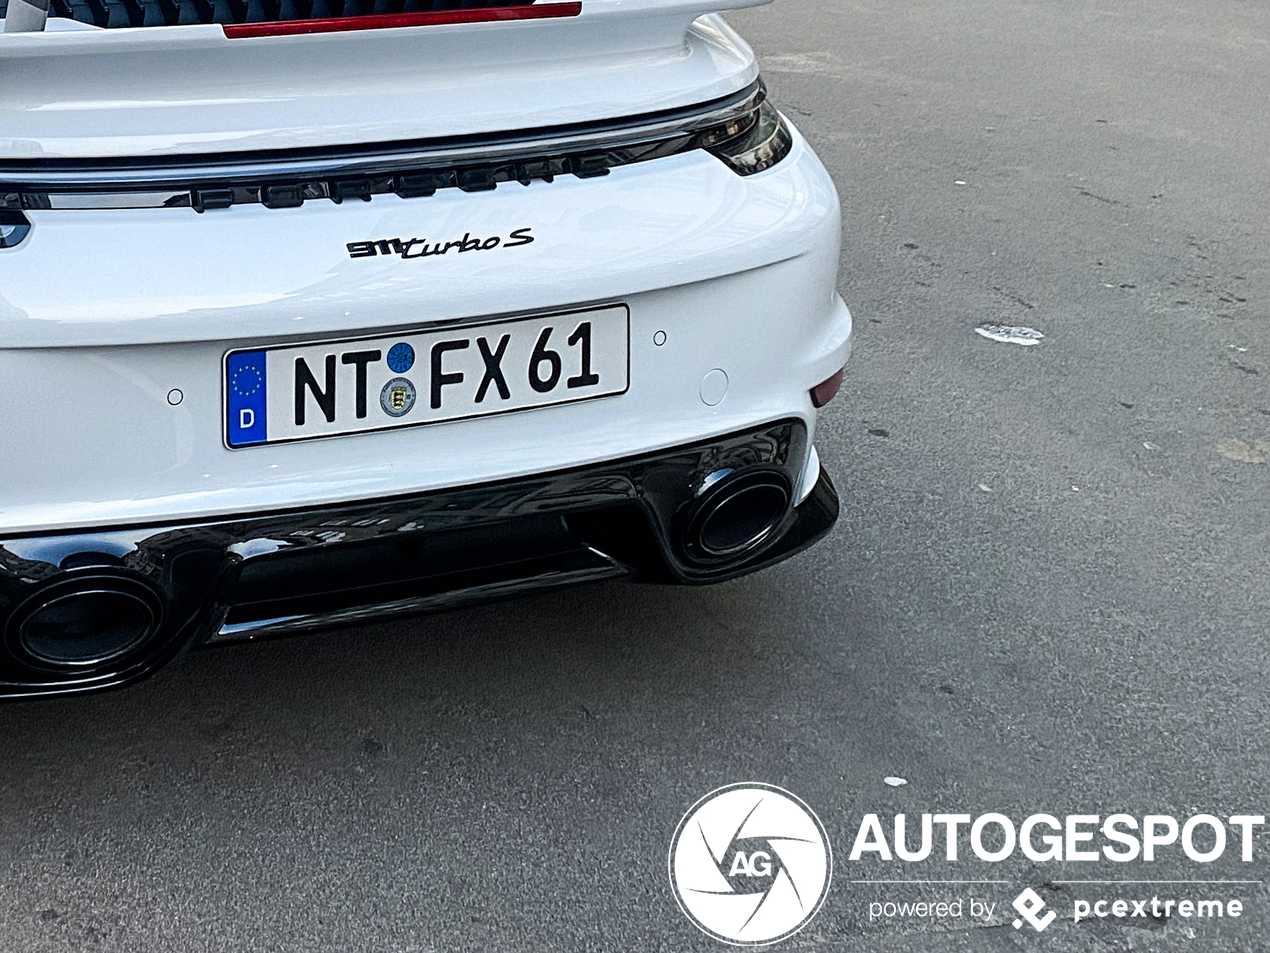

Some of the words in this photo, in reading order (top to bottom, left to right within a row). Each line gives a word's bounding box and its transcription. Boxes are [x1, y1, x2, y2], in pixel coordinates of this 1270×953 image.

[401, 233, 500, 259] turbo
[503, 228, 535, 247] S
[295, 349, 382, 426] NT
[430, 334, 511, 409] FX
[530, 321, 600, 394] 61
[239, 409, 255, 429] D
